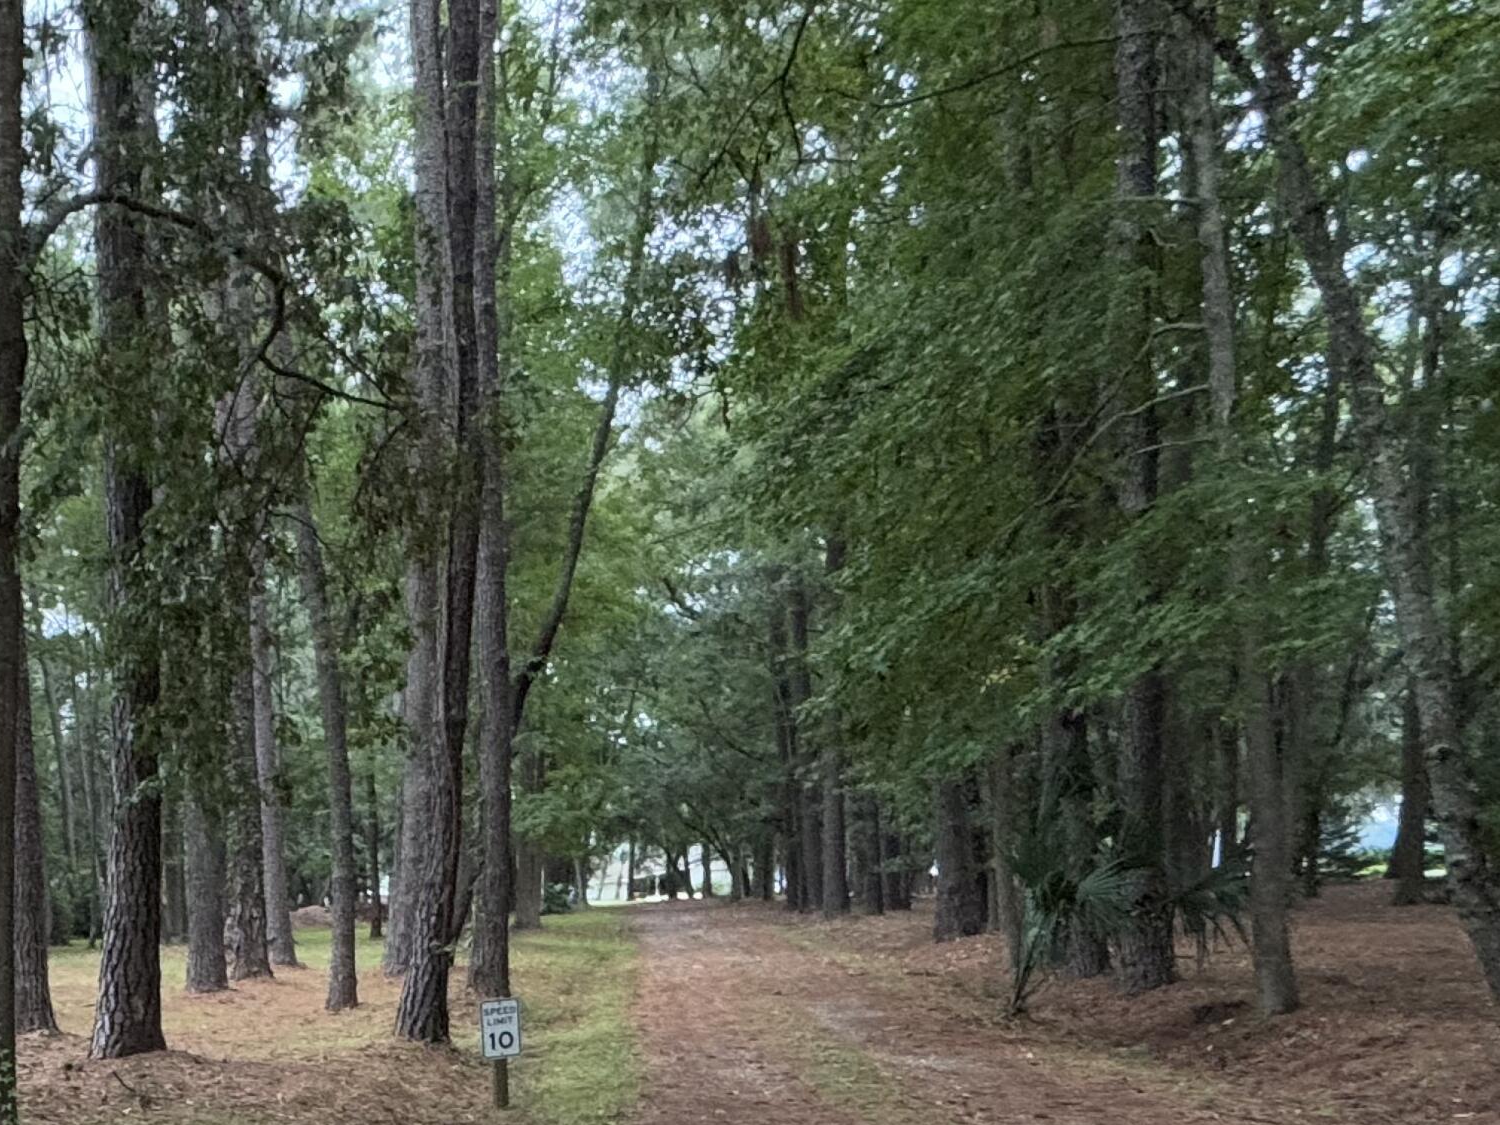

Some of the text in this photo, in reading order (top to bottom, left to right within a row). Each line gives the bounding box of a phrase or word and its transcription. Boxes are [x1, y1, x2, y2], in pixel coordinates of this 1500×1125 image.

[483, 1006, 517, 1016] SPEED
[486, 1016, 513, 1026] LIMIT
[489, 1031, 514, 1050] 10
